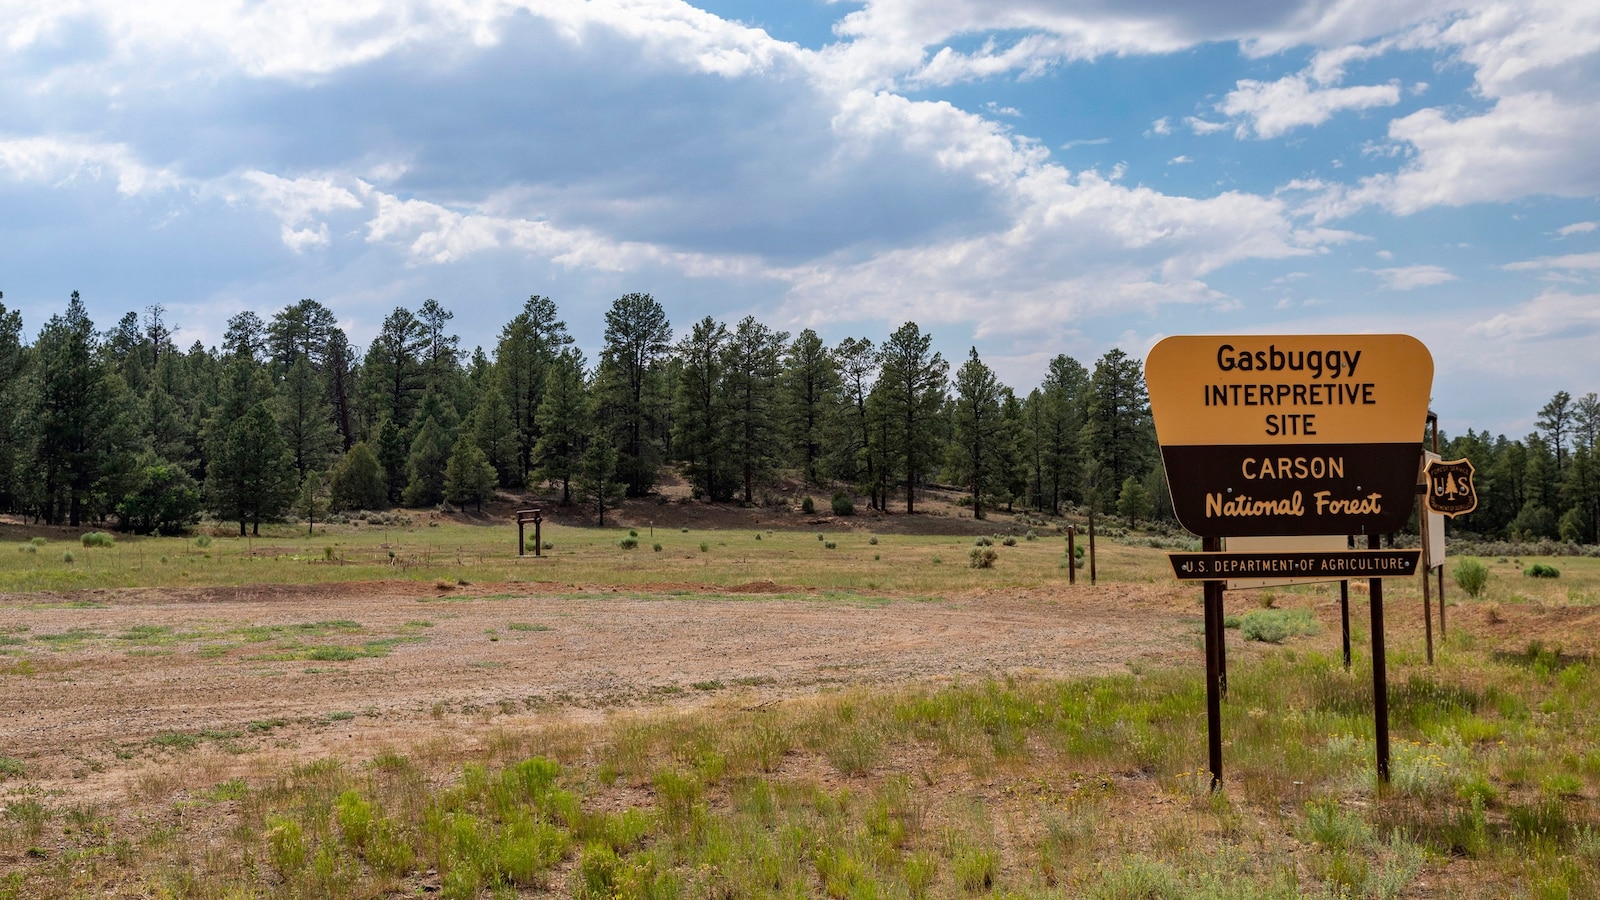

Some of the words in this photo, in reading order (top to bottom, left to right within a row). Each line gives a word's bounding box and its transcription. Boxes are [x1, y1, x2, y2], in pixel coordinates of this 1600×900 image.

[1217, 344, 1362, 379] Gasbuggy
[1205, 383, 1376, 406] INTERPRETIVE
[1265, 414, 1317, 436] SITE
[1241, 456, 1344, 480] CARSON
[1205, 490, 1305, 518] National
[1313, 490, 1382, 516] Forest
[1185, 560, 1209, 573] U.S.
[1214, 559, 1294, 572] DEPARTMENT
[1300, 558, 1315, 571] OF
[1321, 557, 1405, 571] AGRICULTURE
